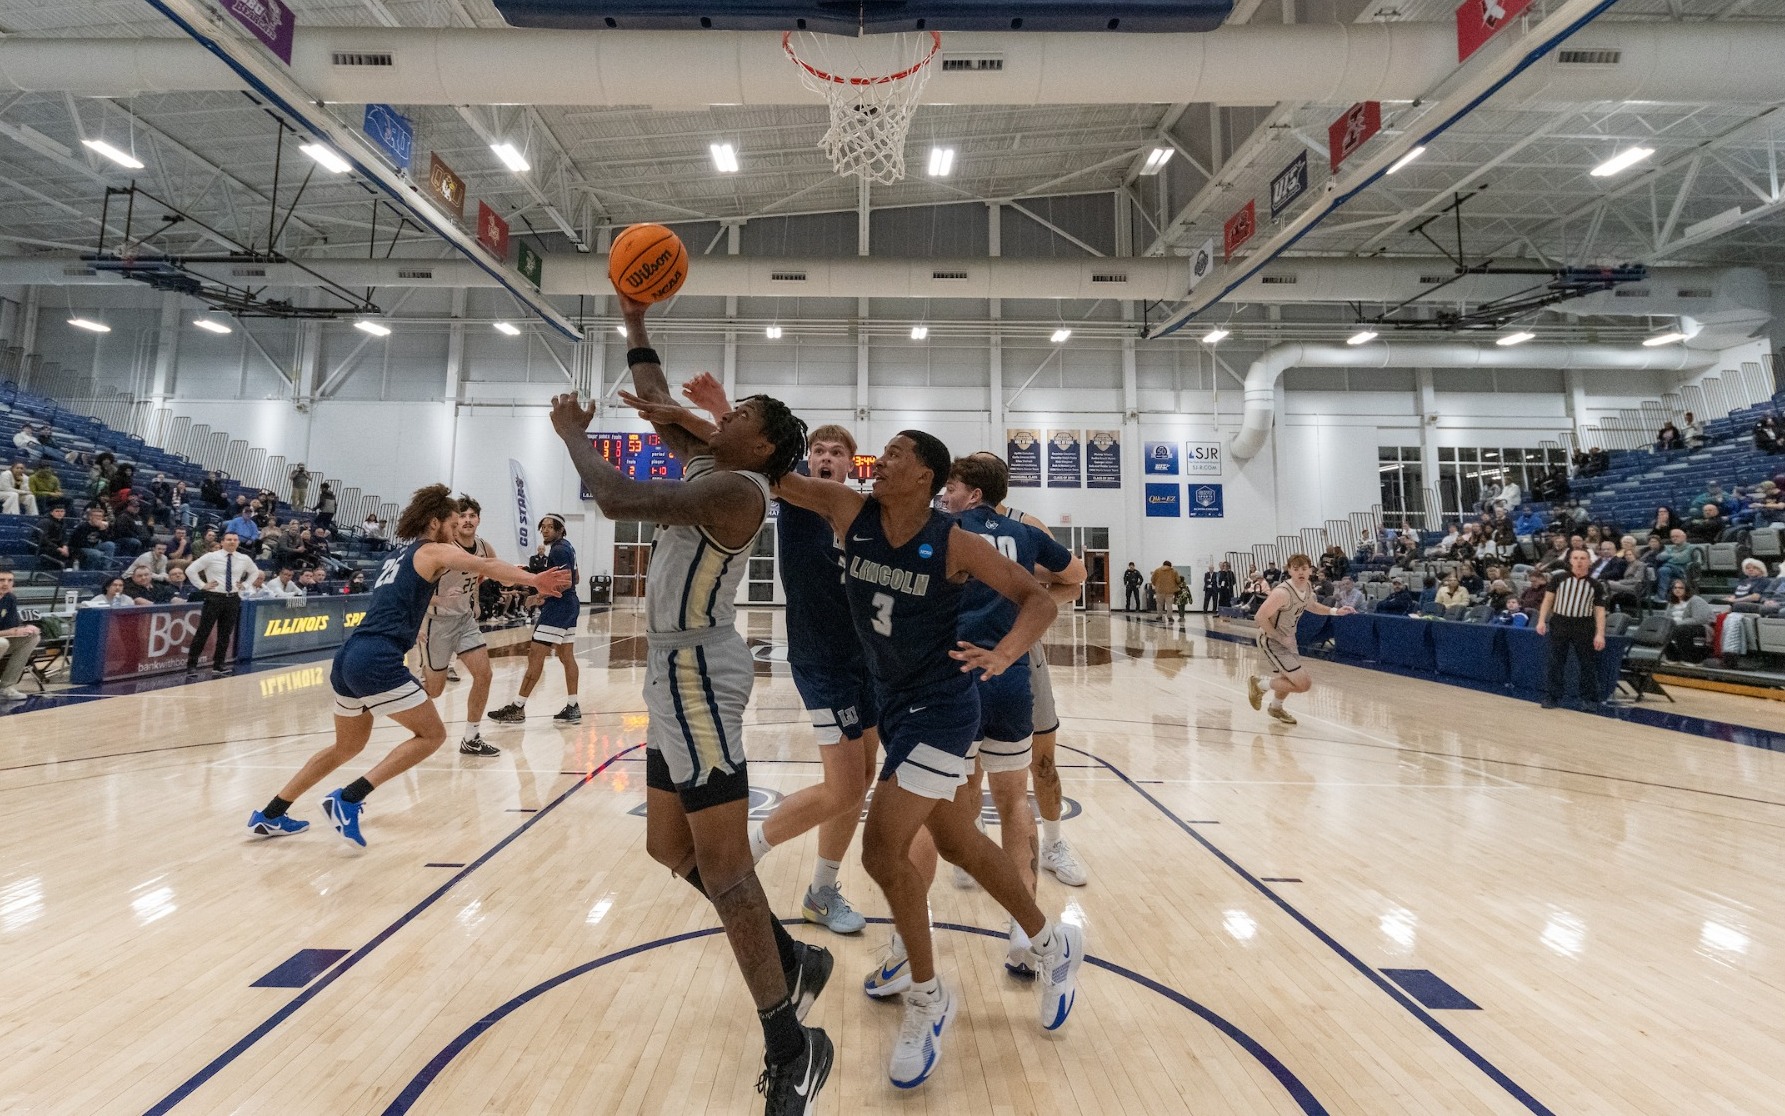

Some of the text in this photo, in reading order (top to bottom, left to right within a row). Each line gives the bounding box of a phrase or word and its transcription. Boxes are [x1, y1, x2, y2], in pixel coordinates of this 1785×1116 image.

[626, 249, 672, 288] Wilson
[651, 270, 682, 298] NCAA
[603, 449, 609, 458] 3
[604, 440, 610, 449] 0
[616, 440, 622, 449] 0
[628, 441, 642, 452] 53
[1195, 447, 1218, 460] SJR
[629, 466, 635, 475] 2
[852, 456, 876, 466] 3:44
[516, 477, 529, 547] GO STARS
[374, 553, 406, 590] 25
[850, 555, 930, 597] LINCOLN
[462, 575, 478, 595] 22
[870, 591, 895, 638] 3
[264, 615, 330, 637] ILLINOIS
